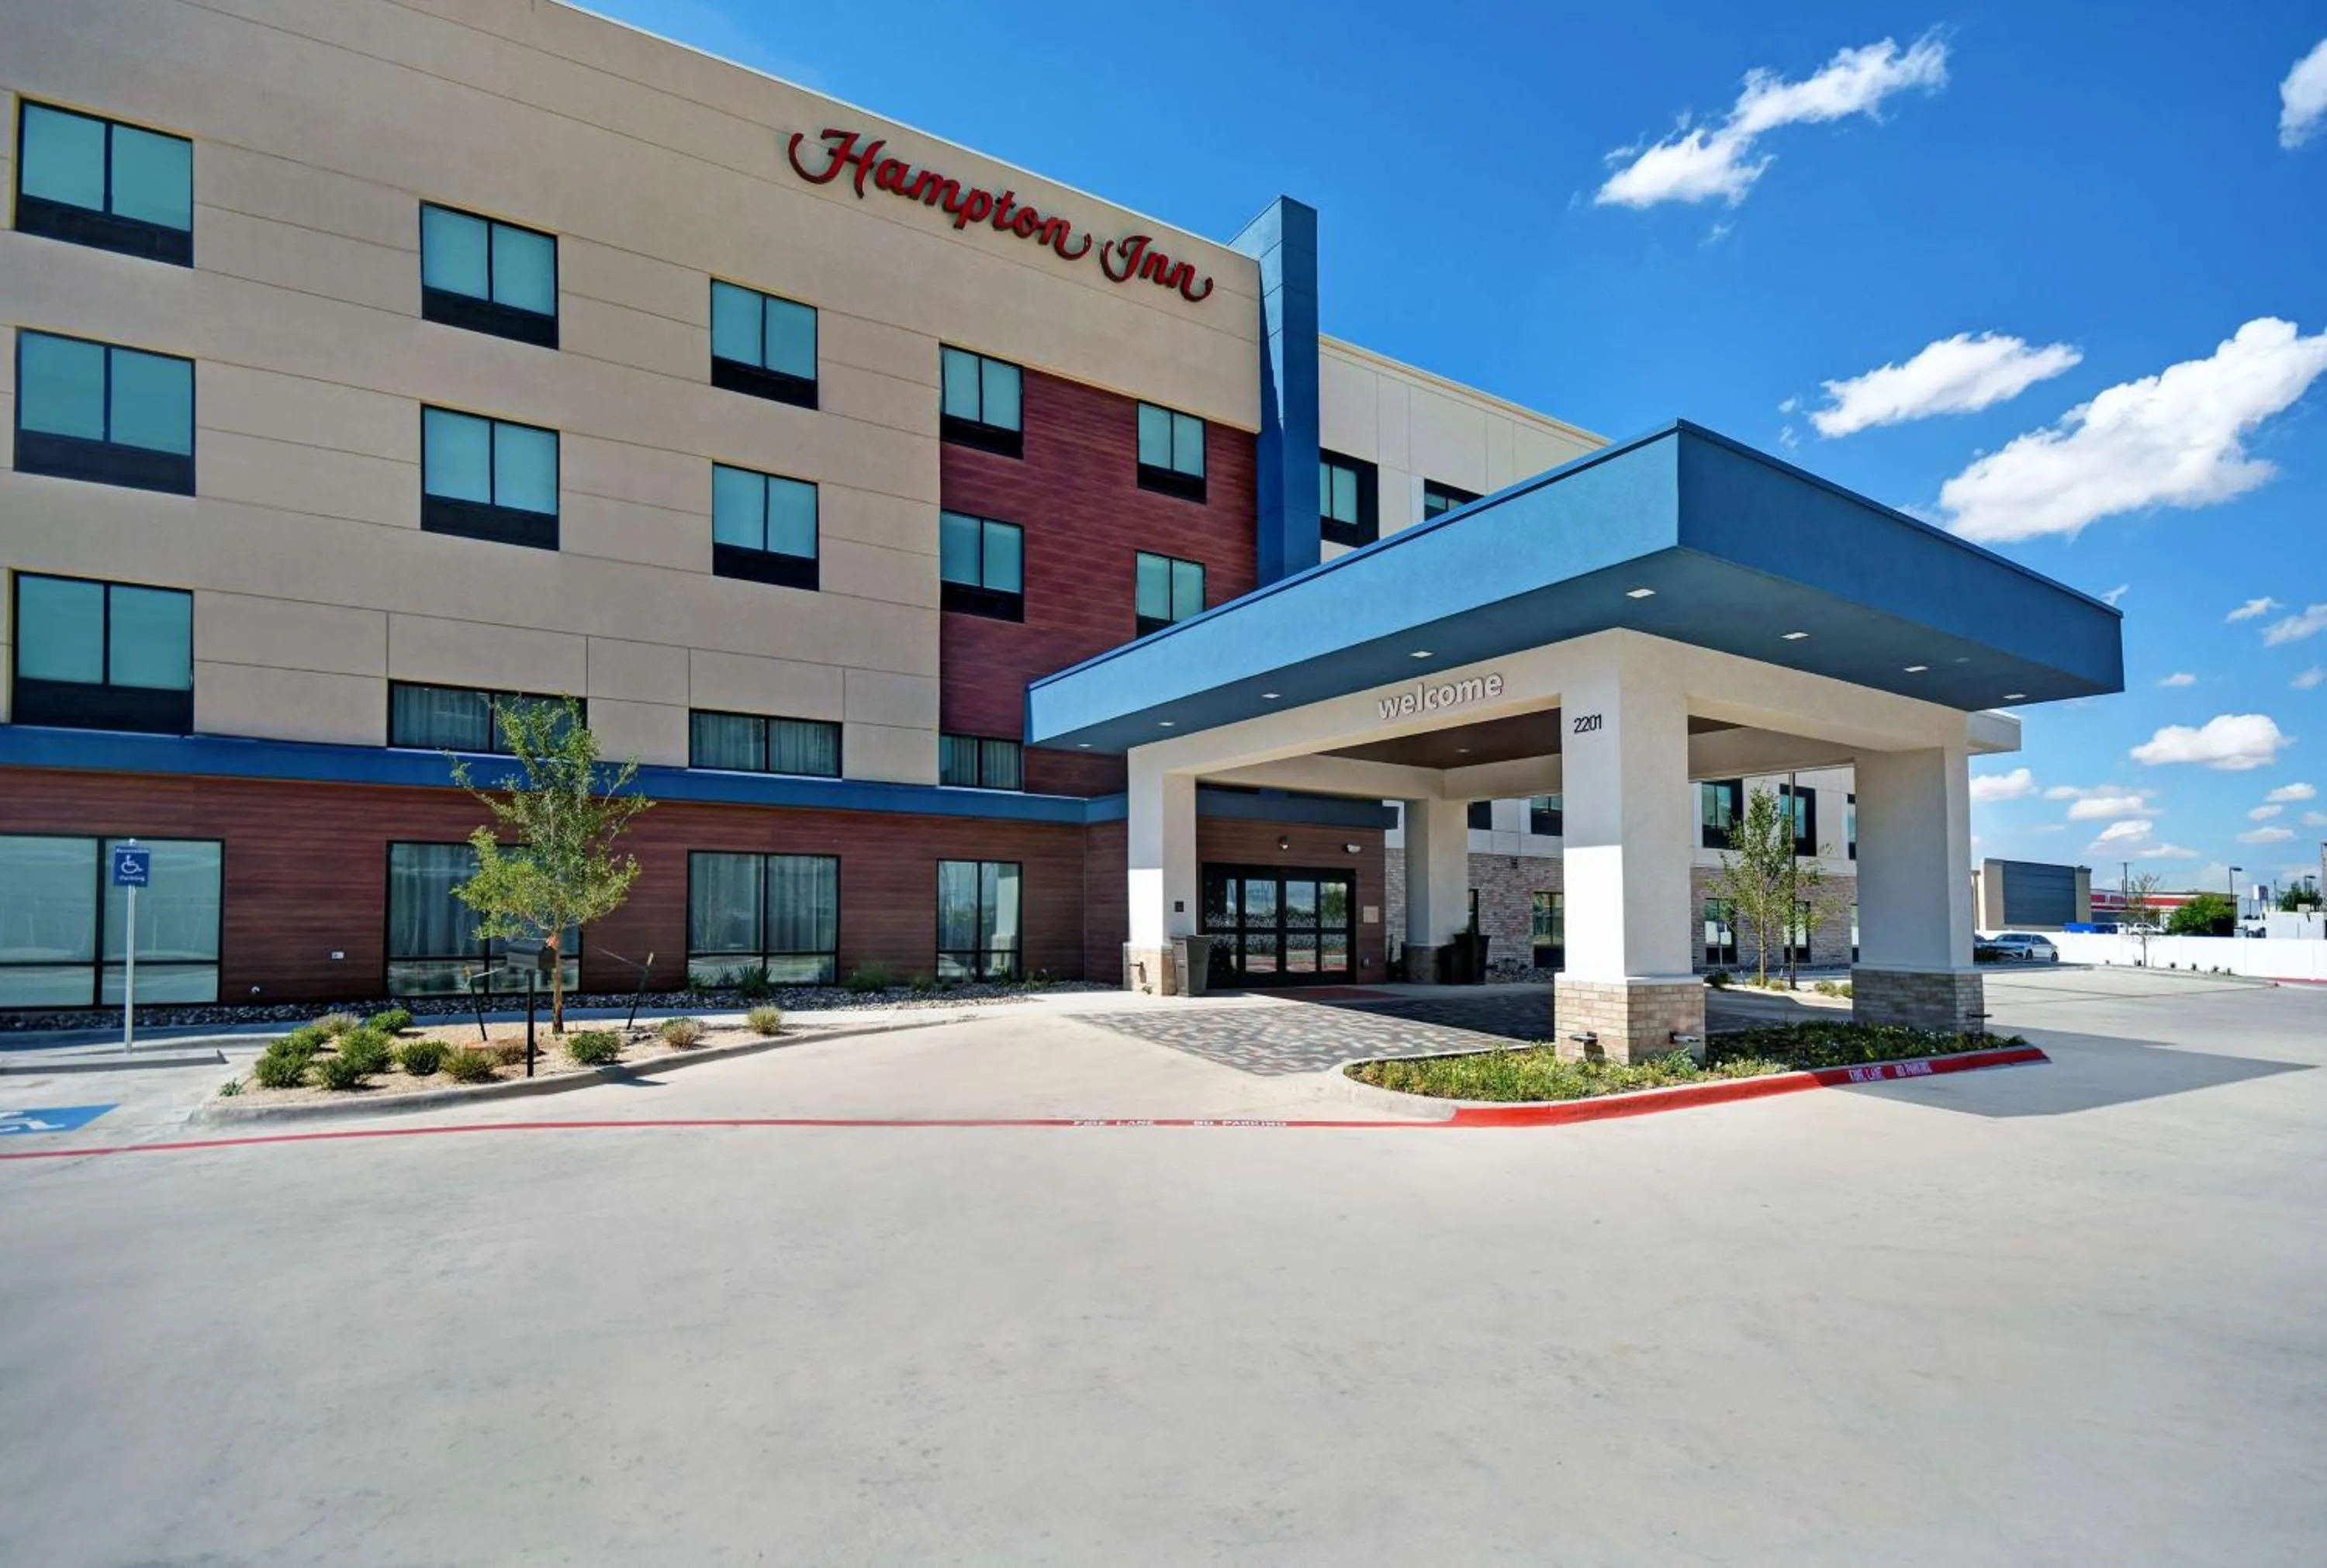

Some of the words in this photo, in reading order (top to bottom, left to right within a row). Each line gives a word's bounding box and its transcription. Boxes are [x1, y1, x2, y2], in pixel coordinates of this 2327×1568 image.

[788, 128, 1091, 261] Hampton
[1100, 235, 1214, 302] Inn
[1377, 672, 1503, 720] welcome
[1574, 713, 1602, 734] 2201
